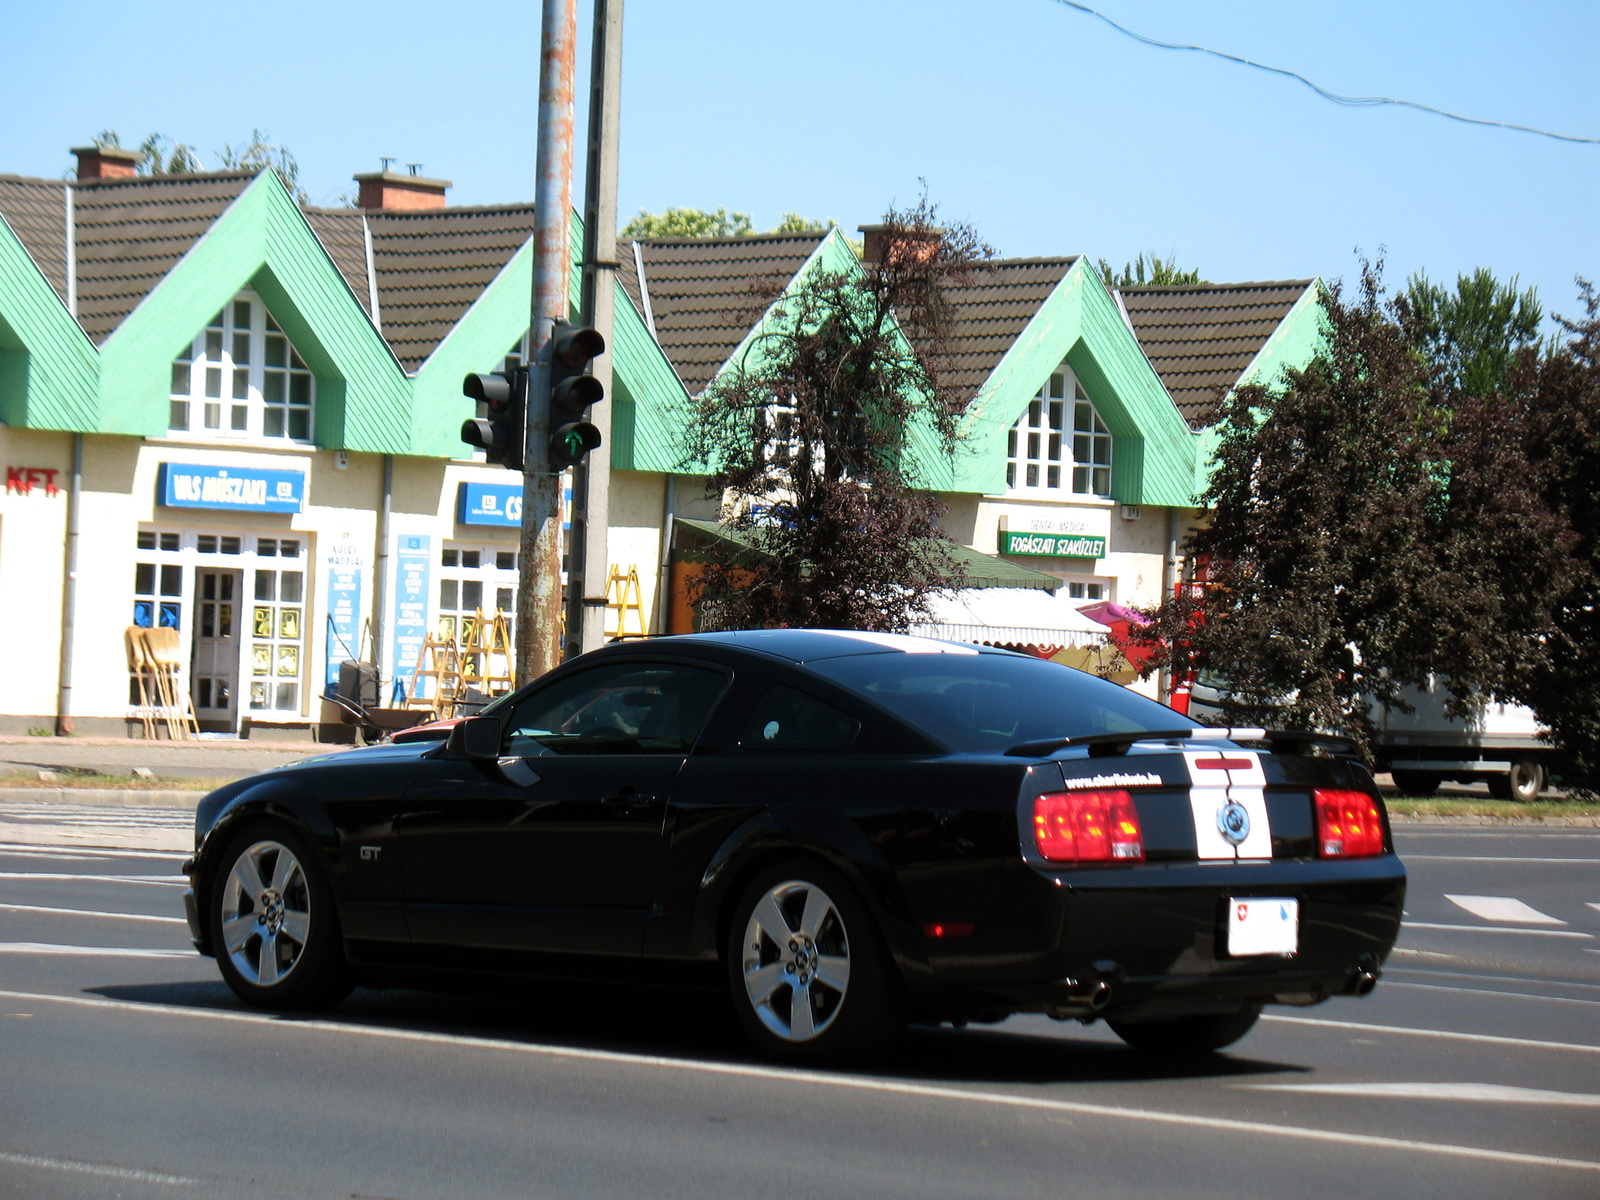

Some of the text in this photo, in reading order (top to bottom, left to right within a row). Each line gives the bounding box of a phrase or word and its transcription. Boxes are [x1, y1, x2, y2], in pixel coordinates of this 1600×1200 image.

[173, 474, 202, 501] VAS
[1010, 534, 1056, 554] FOGÁSZATI
[360, 845, 382, 860] GT
